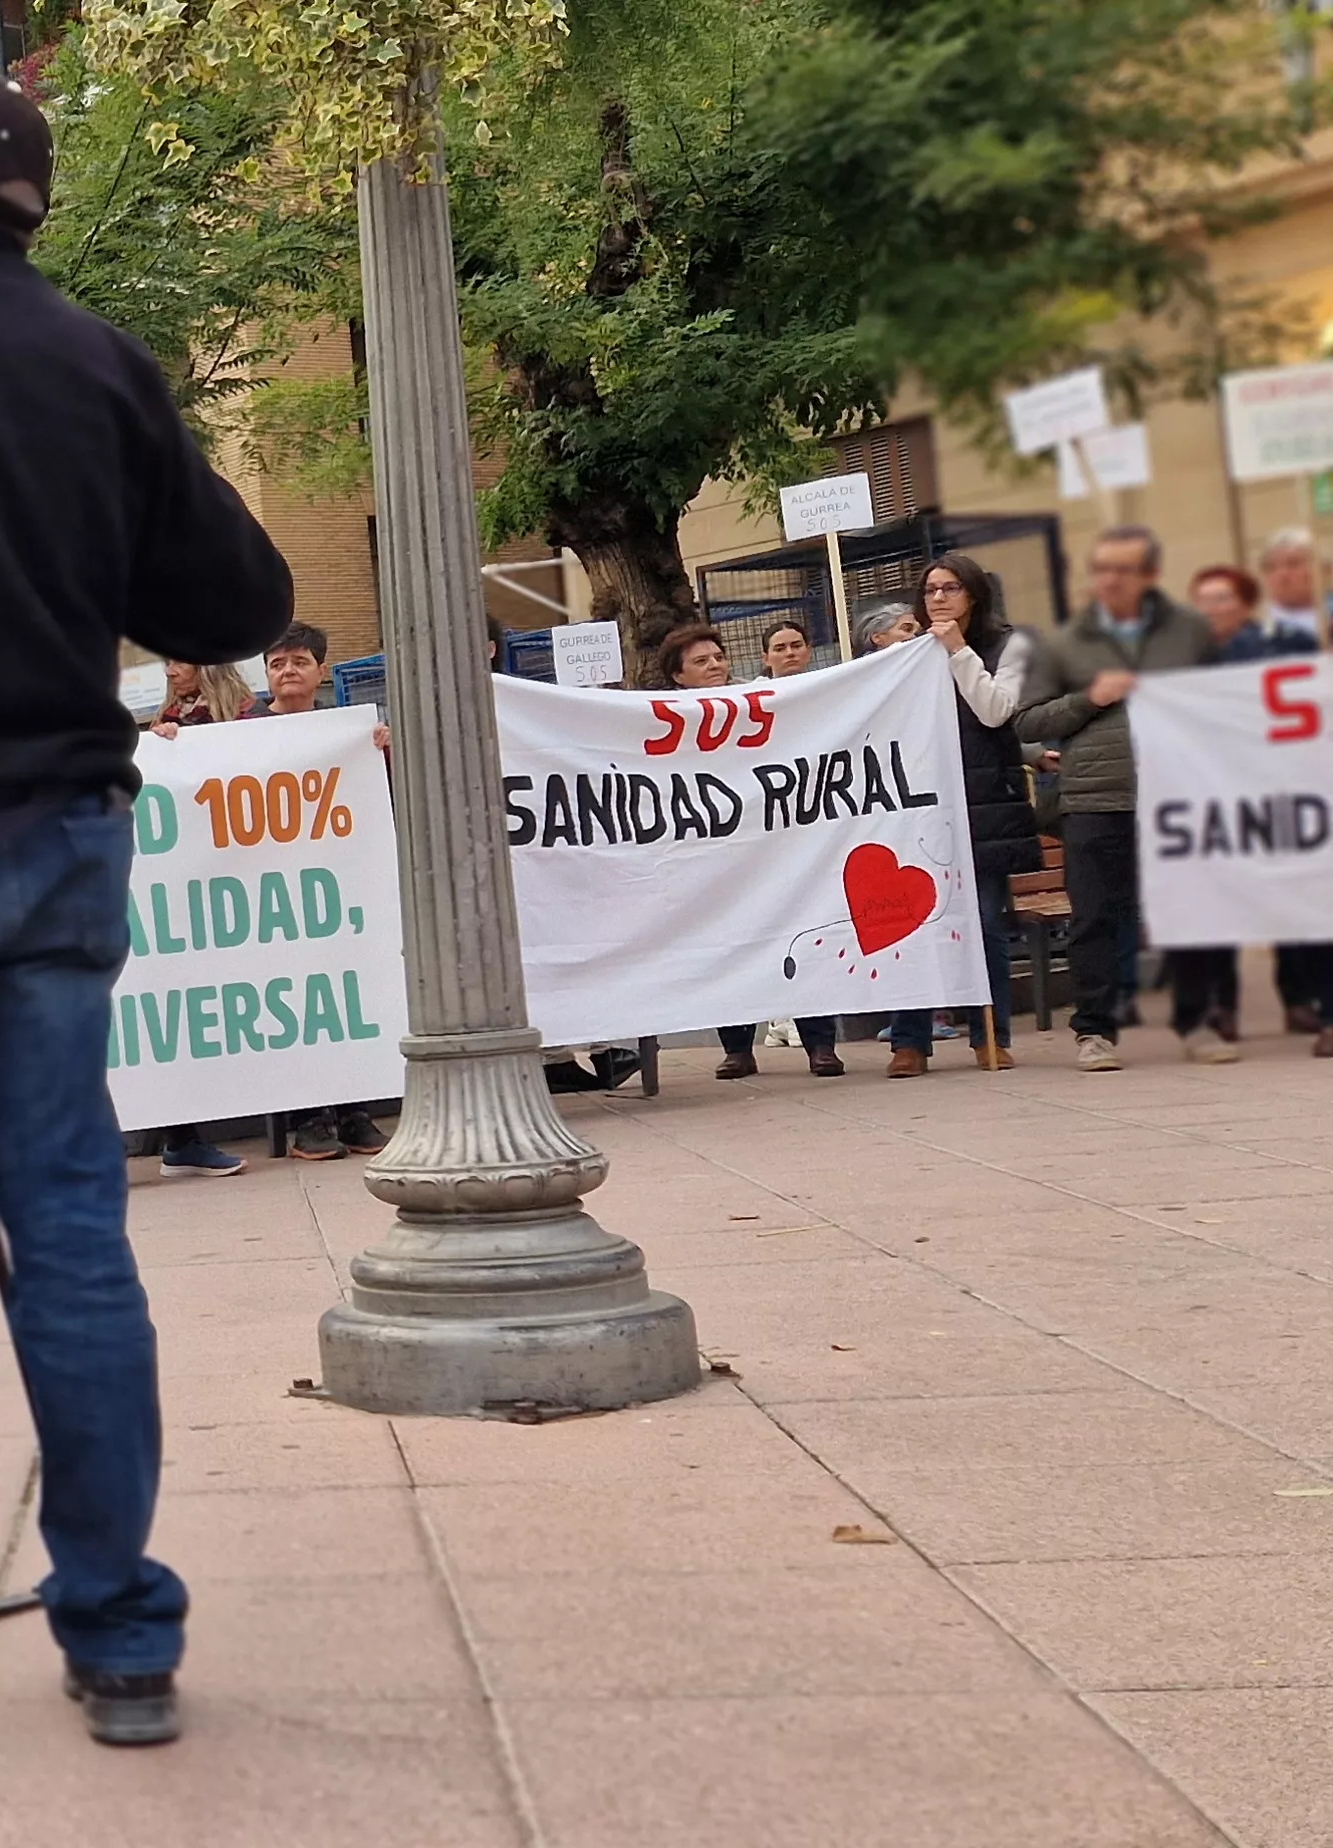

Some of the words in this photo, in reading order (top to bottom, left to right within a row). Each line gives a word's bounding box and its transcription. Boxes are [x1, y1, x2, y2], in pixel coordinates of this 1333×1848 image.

[800, 501, 851, 519] GURREA
[566, 651, 611, 665] GALLEGO
[643, 690, 776, 756] SOS
[193, 766, 353, 850] 100%
[503, 763, 743, 848] SANIDAD
[107, 969, 381, 1069] IVERSAL
